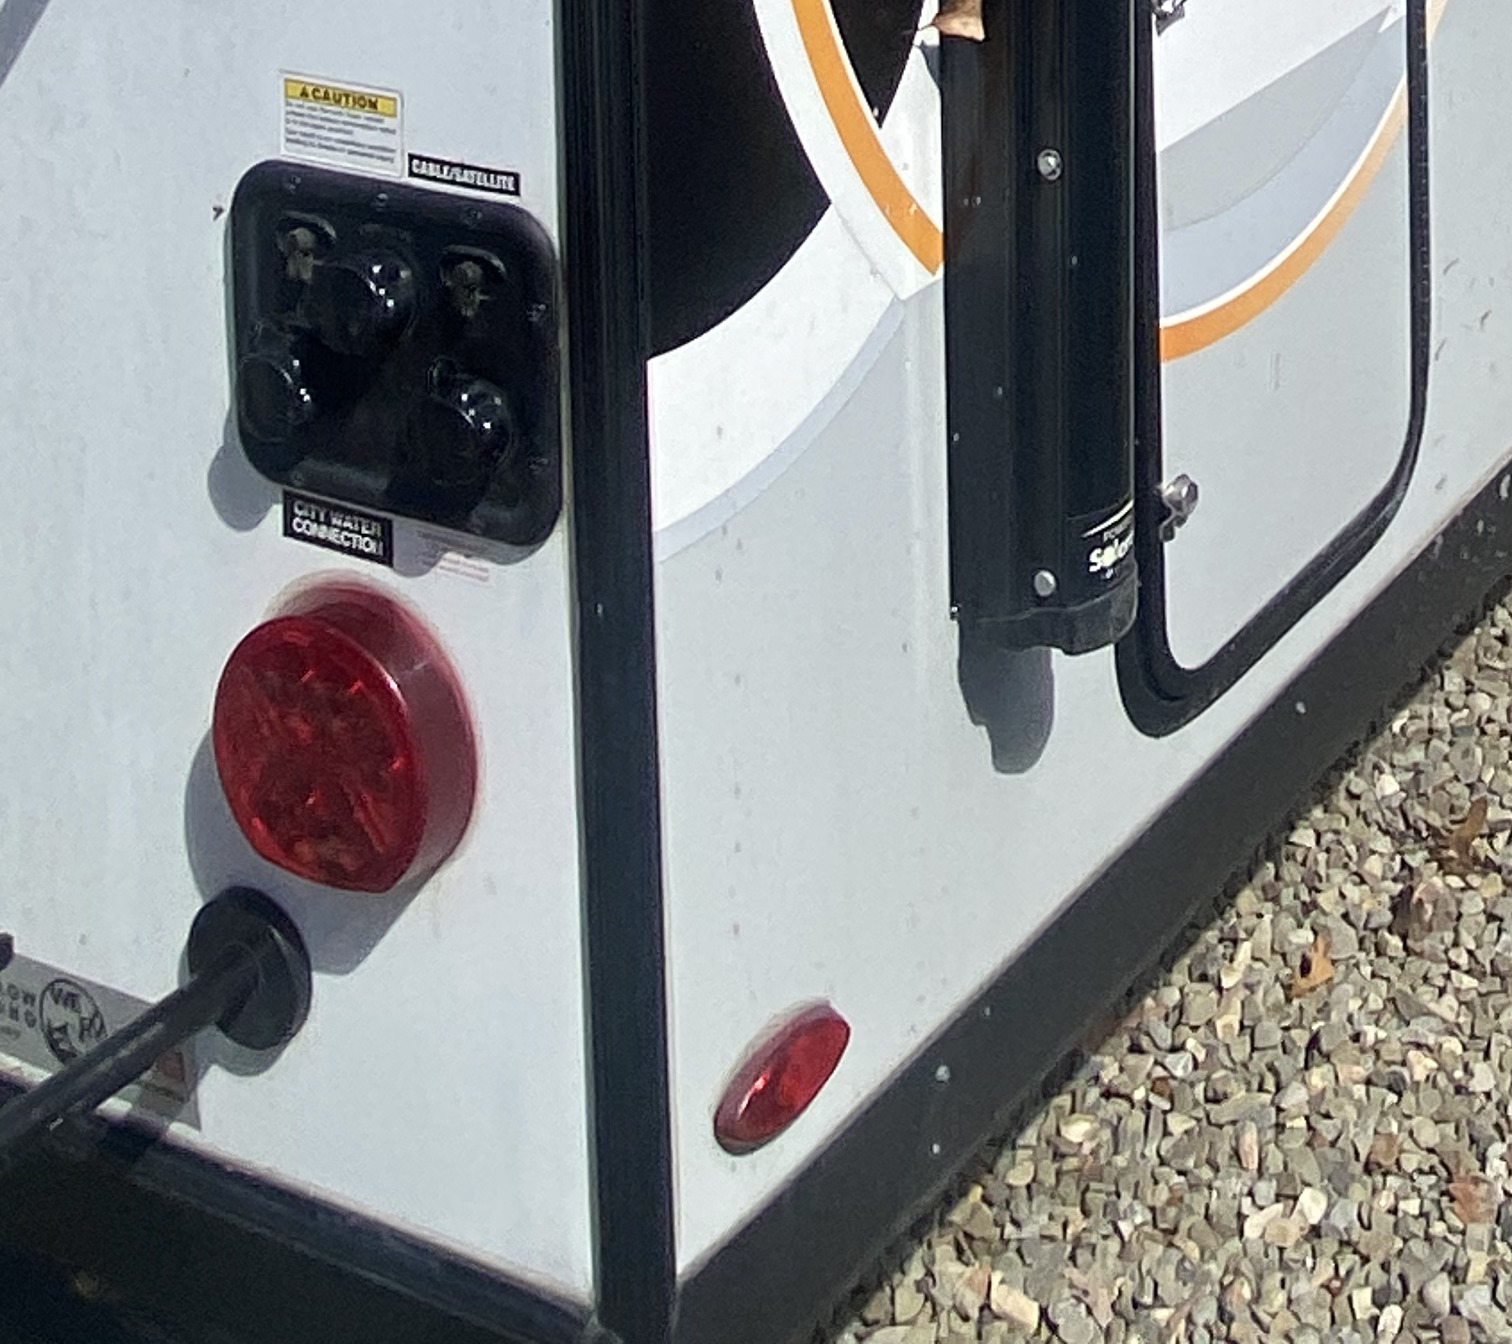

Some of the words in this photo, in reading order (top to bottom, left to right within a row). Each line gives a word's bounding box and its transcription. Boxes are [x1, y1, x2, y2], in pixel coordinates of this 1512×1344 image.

[311, 87, 379, 111] CAUTION
[292, 516, 384, 556] CONNECTION
[294, 500, 326, 522] CITY
[330, 510, 382, 537] WATER
